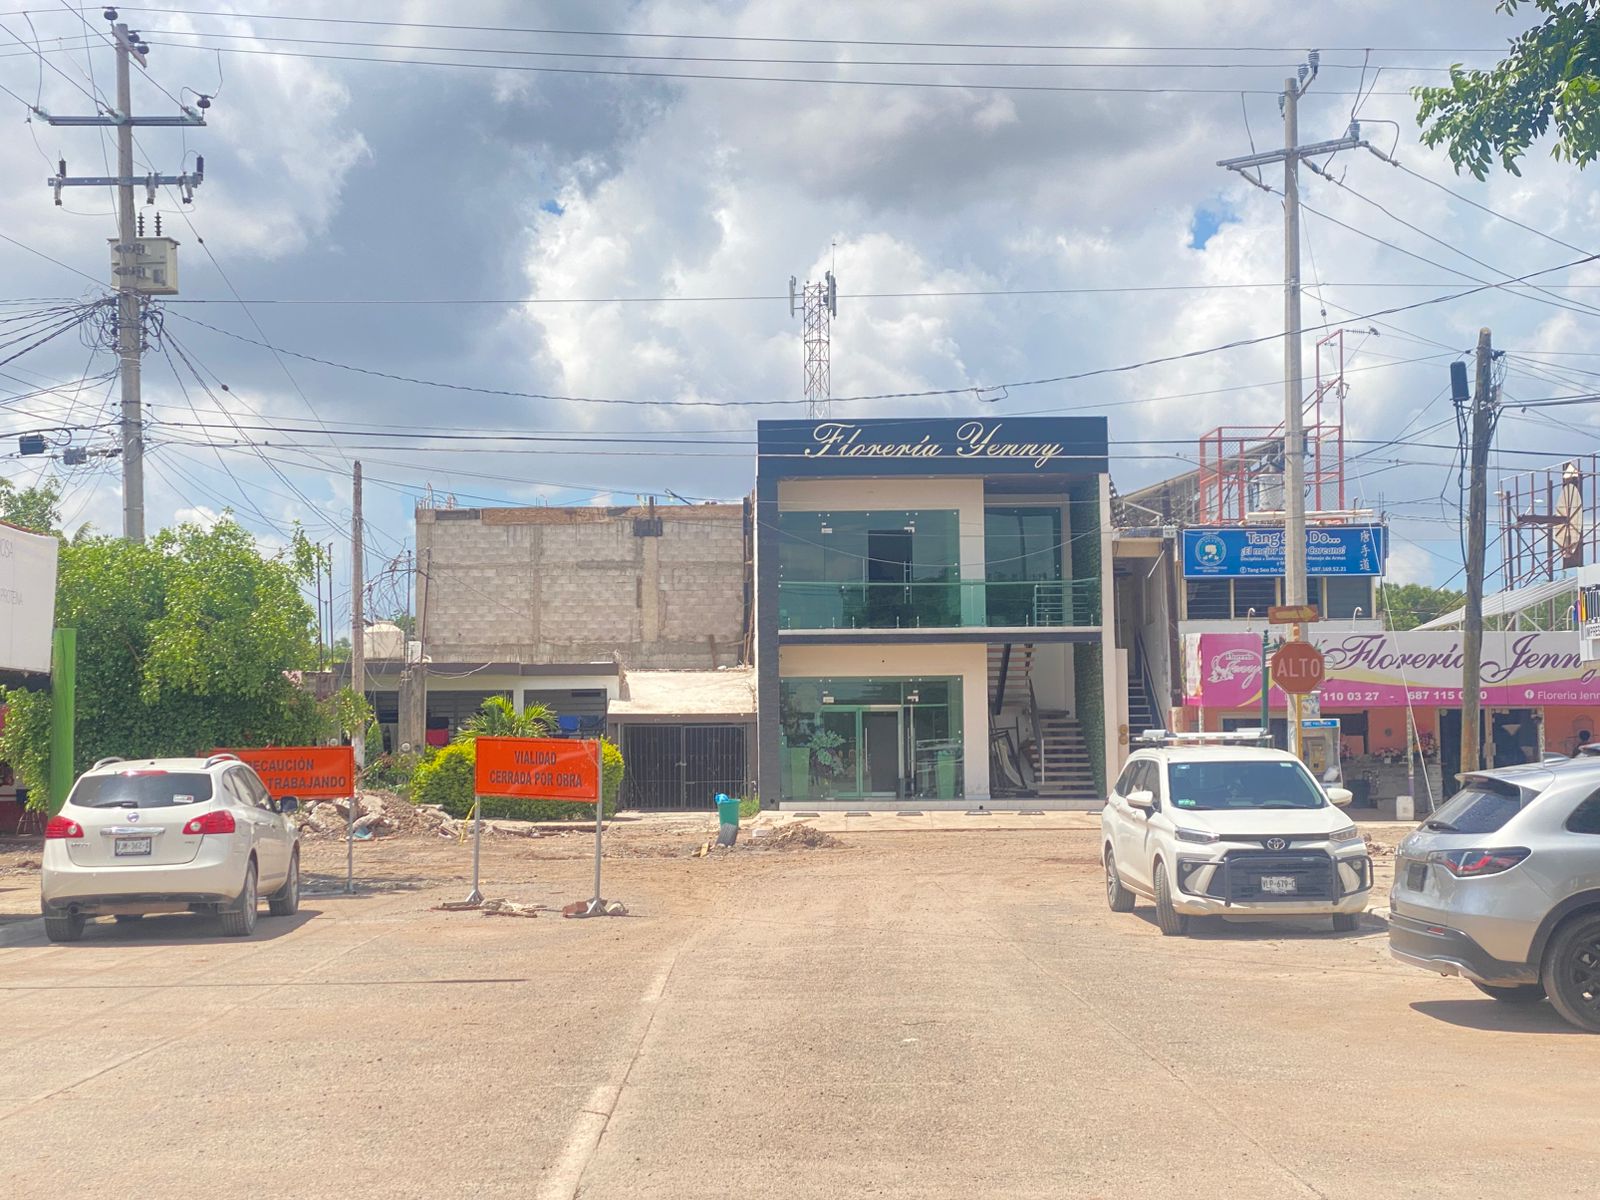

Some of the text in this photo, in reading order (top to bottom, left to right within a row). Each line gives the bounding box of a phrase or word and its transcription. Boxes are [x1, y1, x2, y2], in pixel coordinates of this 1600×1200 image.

[804, 421, 1064, 469] Florería Yenny
[1246, 531, 1280, 547] Tang
[1276, 657, 1321, 678] ALTO
[1323, 692, 1344, 702] 110
[1347, 692, 1361, 702] 03
[1365, 692, 1380, 701] 27
[1408, 691, 1430, 700] 687
[1433, 691, 1455, 700] 115
[514, 751, 557, 766] VIALIDAD
[267, 776, 346, 790] TRABAJANDO
[489, 770, 583, 787] CERRADA POR OBRA
